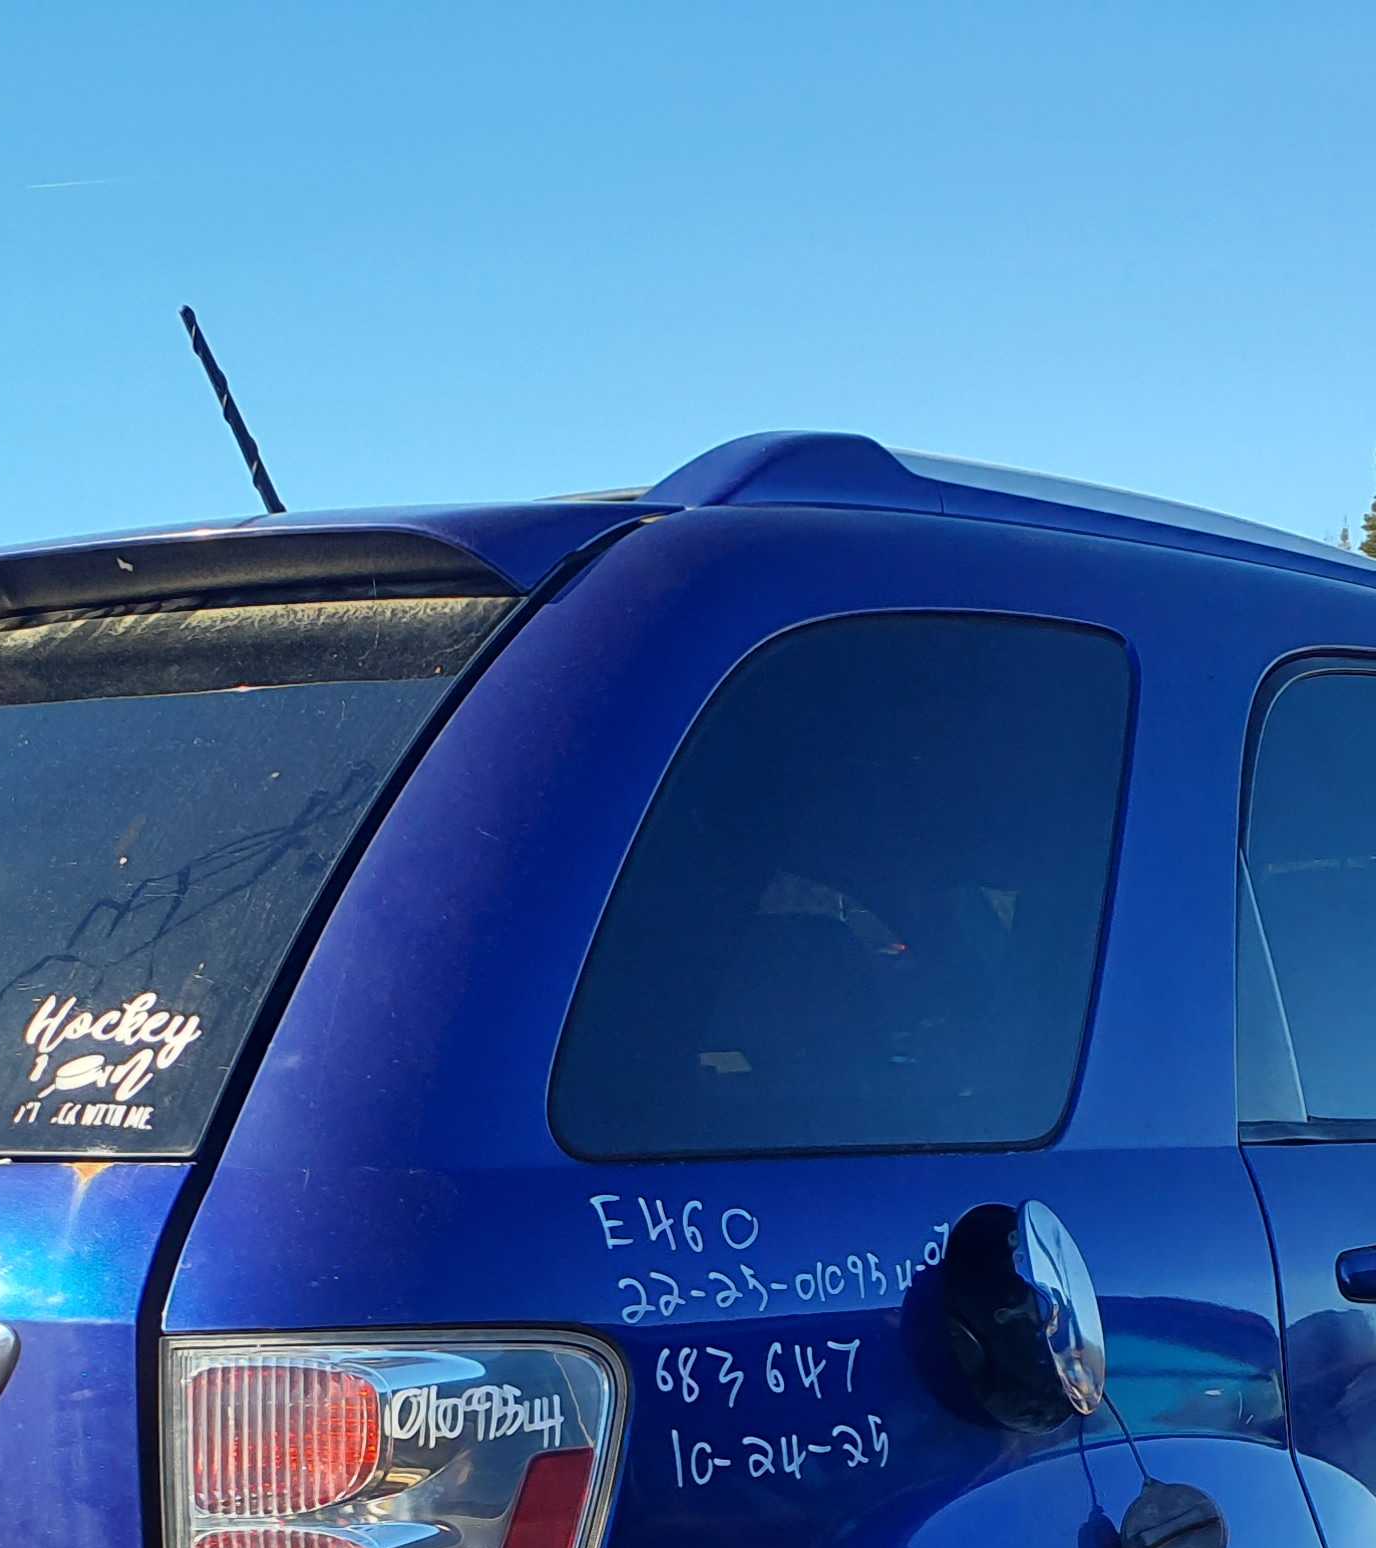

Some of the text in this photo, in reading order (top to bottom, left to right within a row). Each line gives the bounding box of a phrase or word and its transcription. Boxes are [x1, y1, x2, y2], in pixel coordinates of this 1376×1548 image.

[25, 992, 202, 1069] Hockey
[590, 1195, 759, 1253] E460
[672, 1414, 889, 1489] 10-24-25
